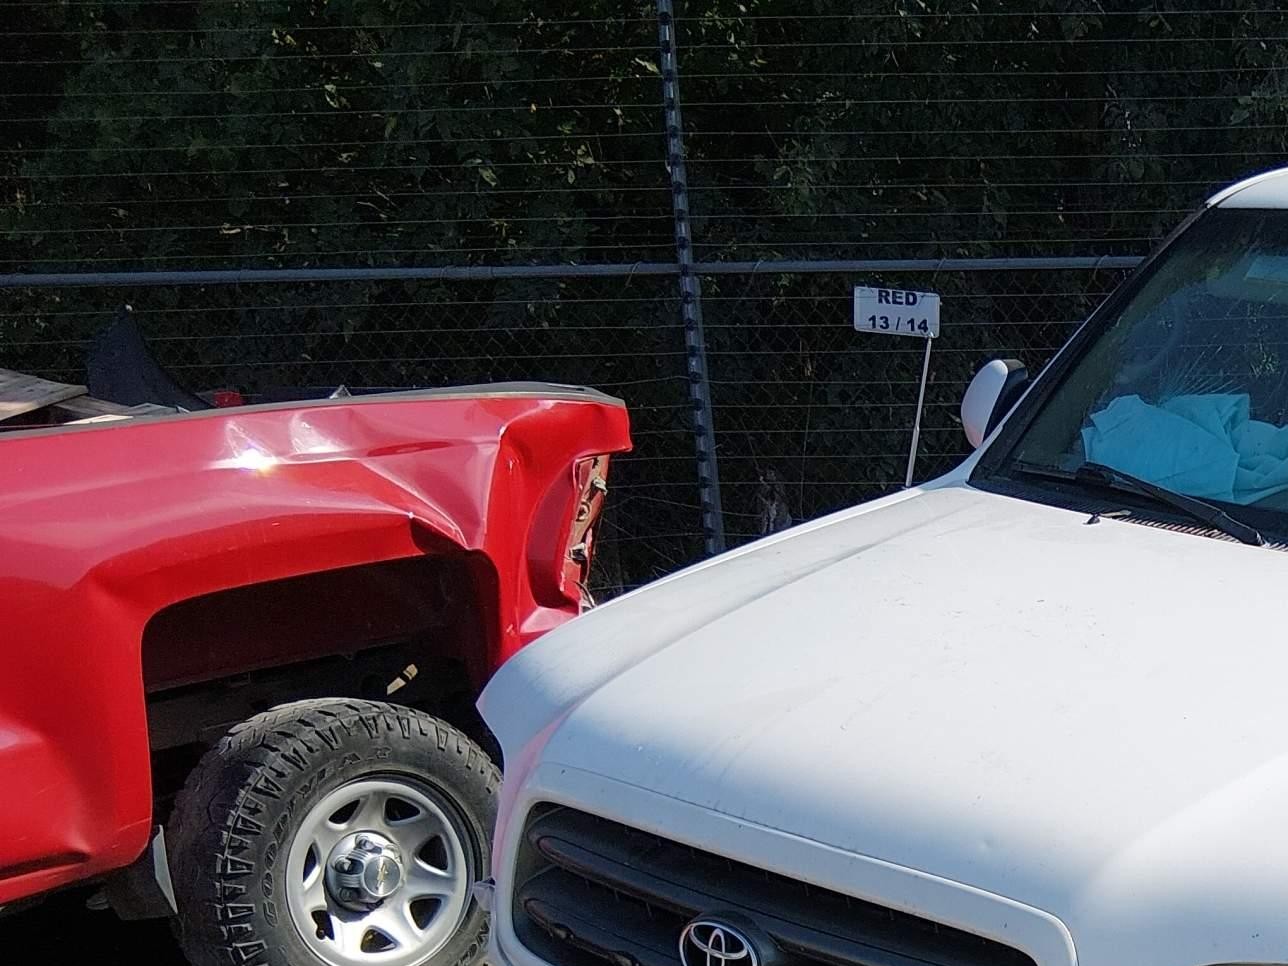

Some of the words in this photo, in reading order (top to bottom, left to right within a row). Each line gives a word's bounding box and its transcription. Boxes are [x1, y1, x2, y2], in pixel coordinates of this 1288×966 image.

[878, 289, 918, 306] RED
[868, 315, 890, 330] 13
[906, 318, 929, 333] 14
